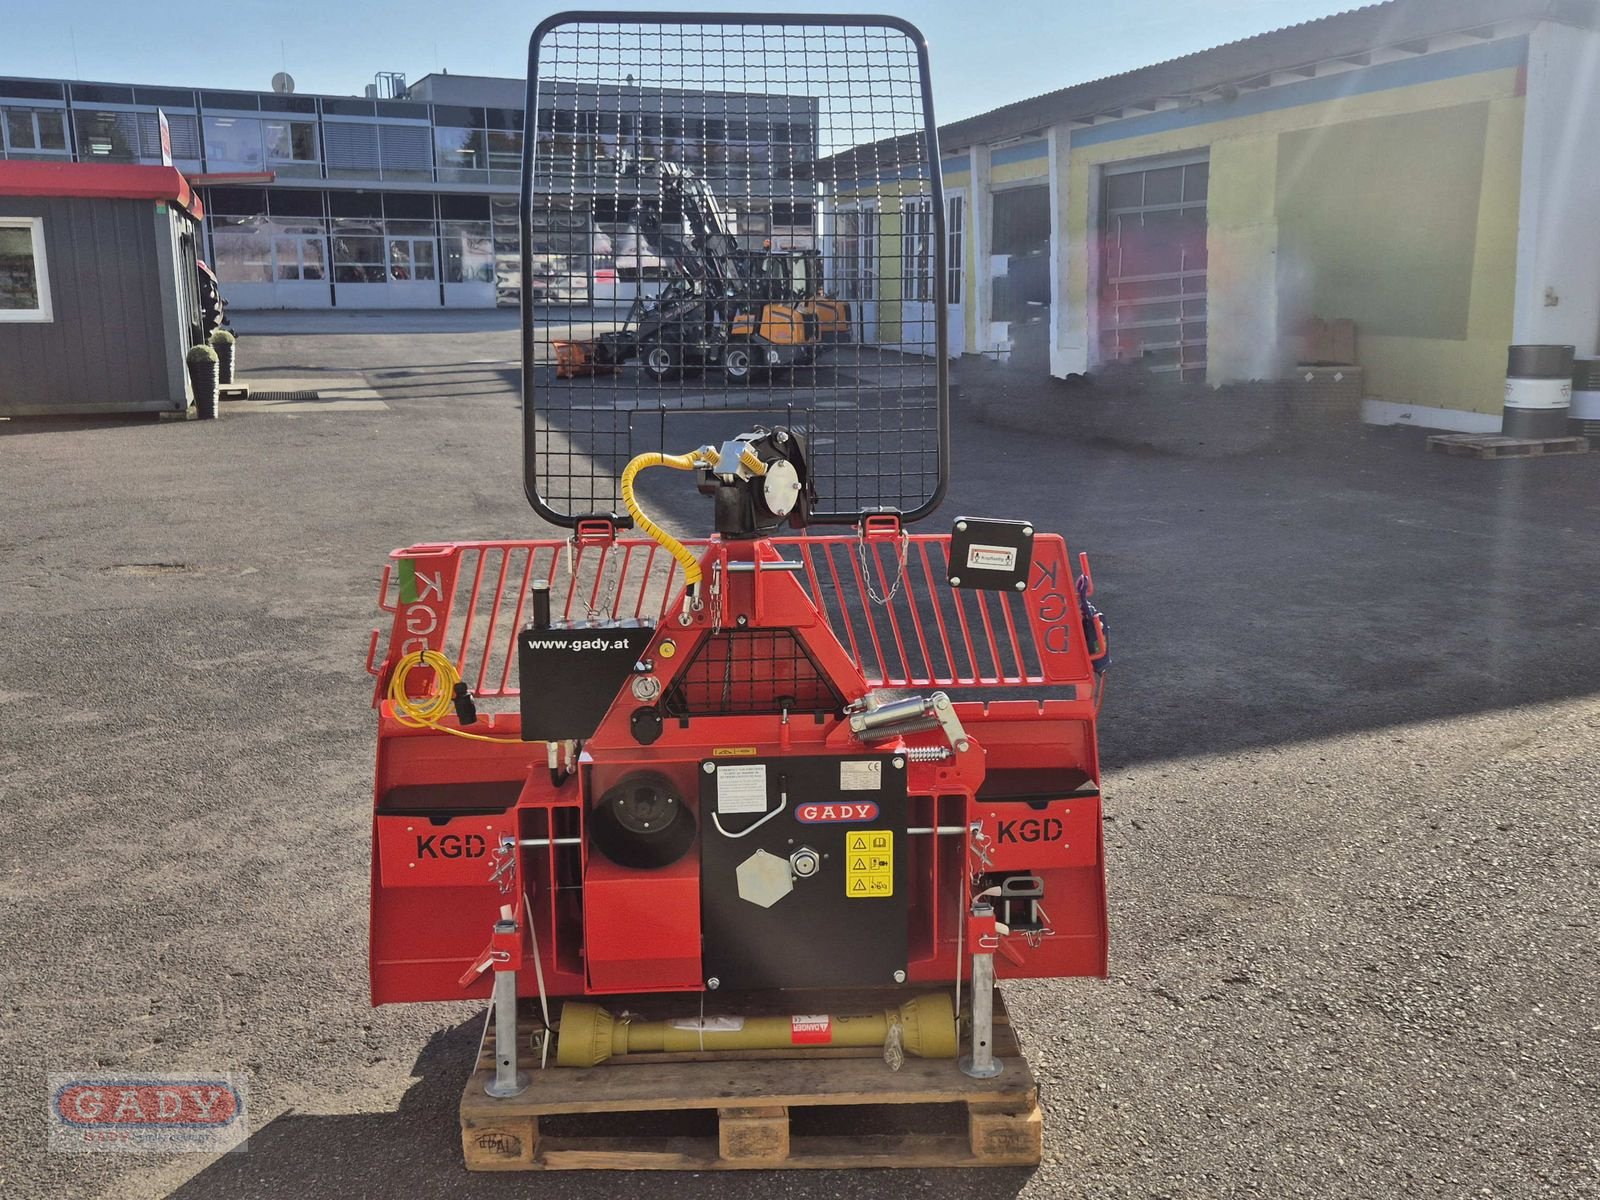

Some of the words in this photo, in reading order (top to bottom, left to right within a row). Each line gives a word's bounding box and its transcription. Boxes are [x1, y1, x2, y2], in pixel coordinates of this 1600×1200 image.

[528, 638, 630, 652] www.gady.at
[803, 804, 871, 820] GADY
[997, 818, 1063, 844] KGD
[416, 834, 487, 860] KGD
